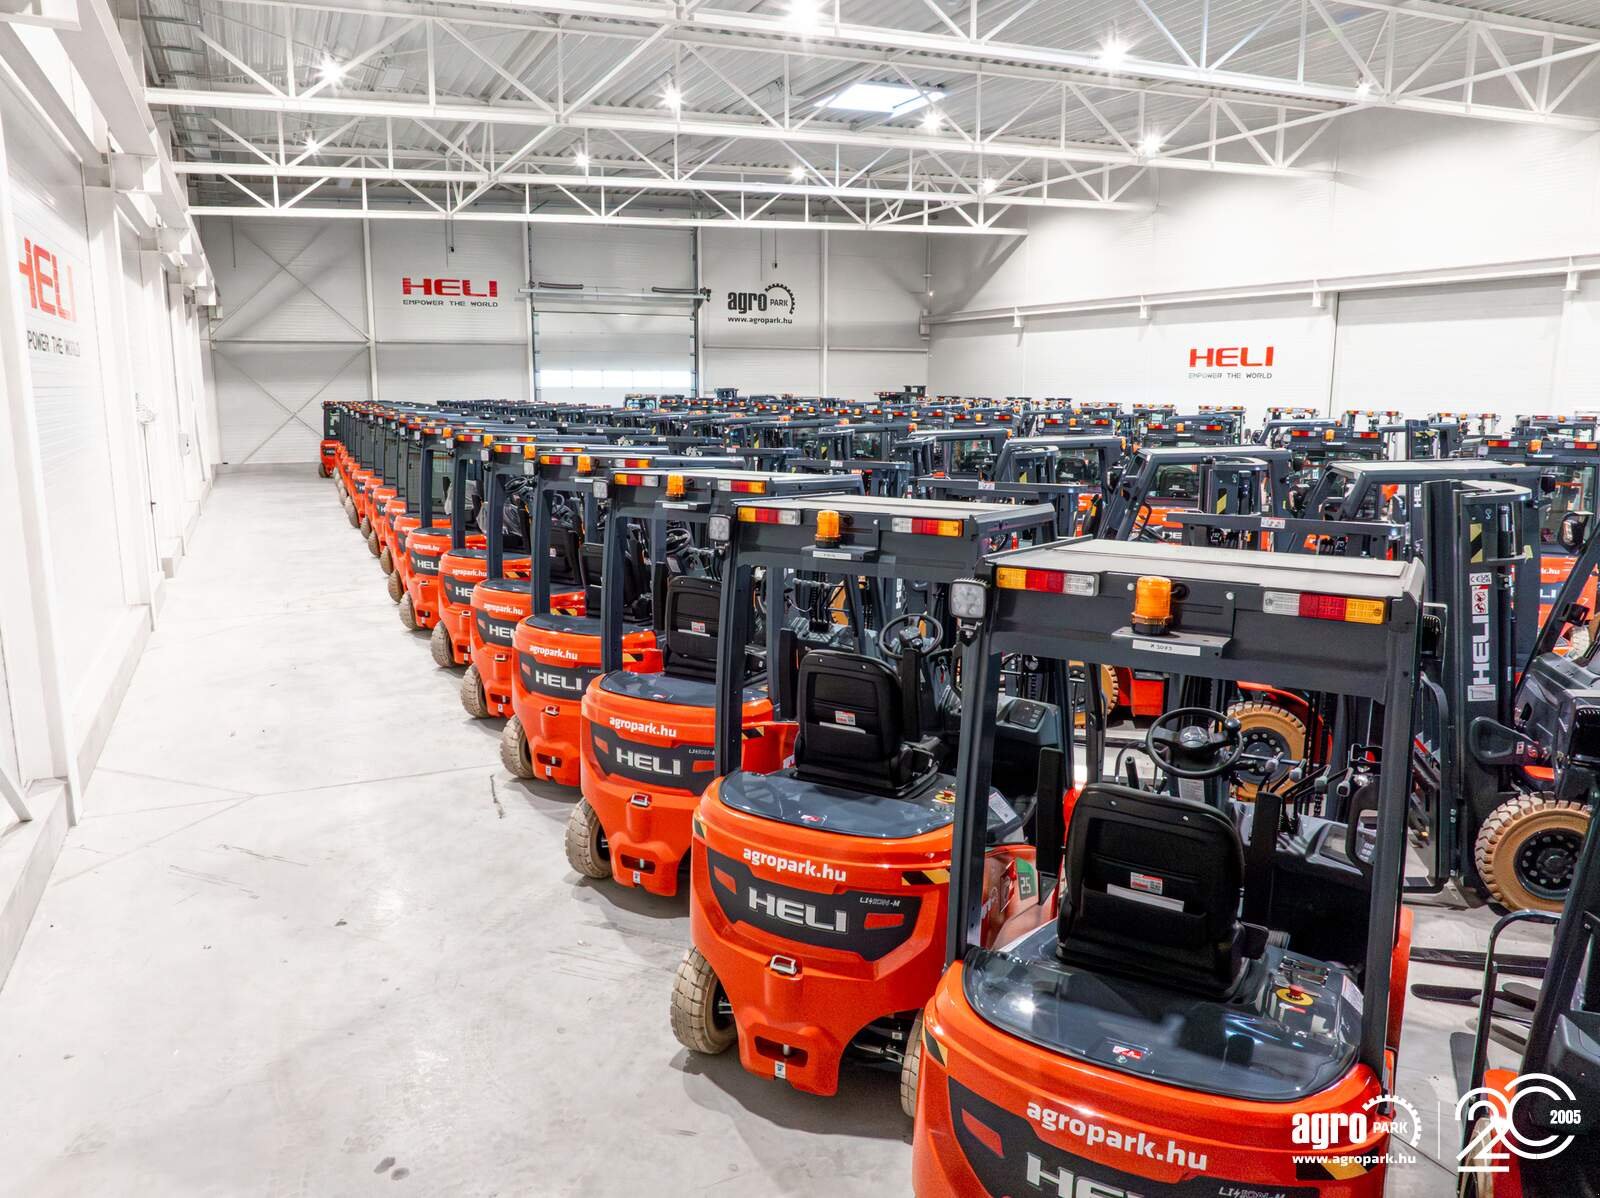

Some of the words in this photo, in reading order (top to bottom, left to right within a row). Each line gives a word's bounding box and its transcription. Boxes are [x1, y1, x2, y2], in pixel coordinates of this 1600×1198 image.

[402, 278, 498, 297] HELI
[728, 292, 768, 314] agro
[728, 317, 793, 325] www.agropark.hu
[27, 330, 49, 352] POWER
[1189, 346, 1275, 368] HELI
[1413, 484, 1422, 508] HEL
[417, 559, 439, 570] HEL
[456, 586, 473, 597] HE
[529, 644, 578, 661] agropark.hu
[1472, 615, 1490, 685] HELI
[535, 670, 583, 691] HELI
[609, 716, 678, 738] agropark.hu
[616, 747, 682, 776] HELI
[743, 848, 847, 883] agropark.hu
[748, 886, 848, 933] HELI
[1026, 1101, 1208, 1171] agropark.hu
[1026, 1151, 1144, 1198] HE
